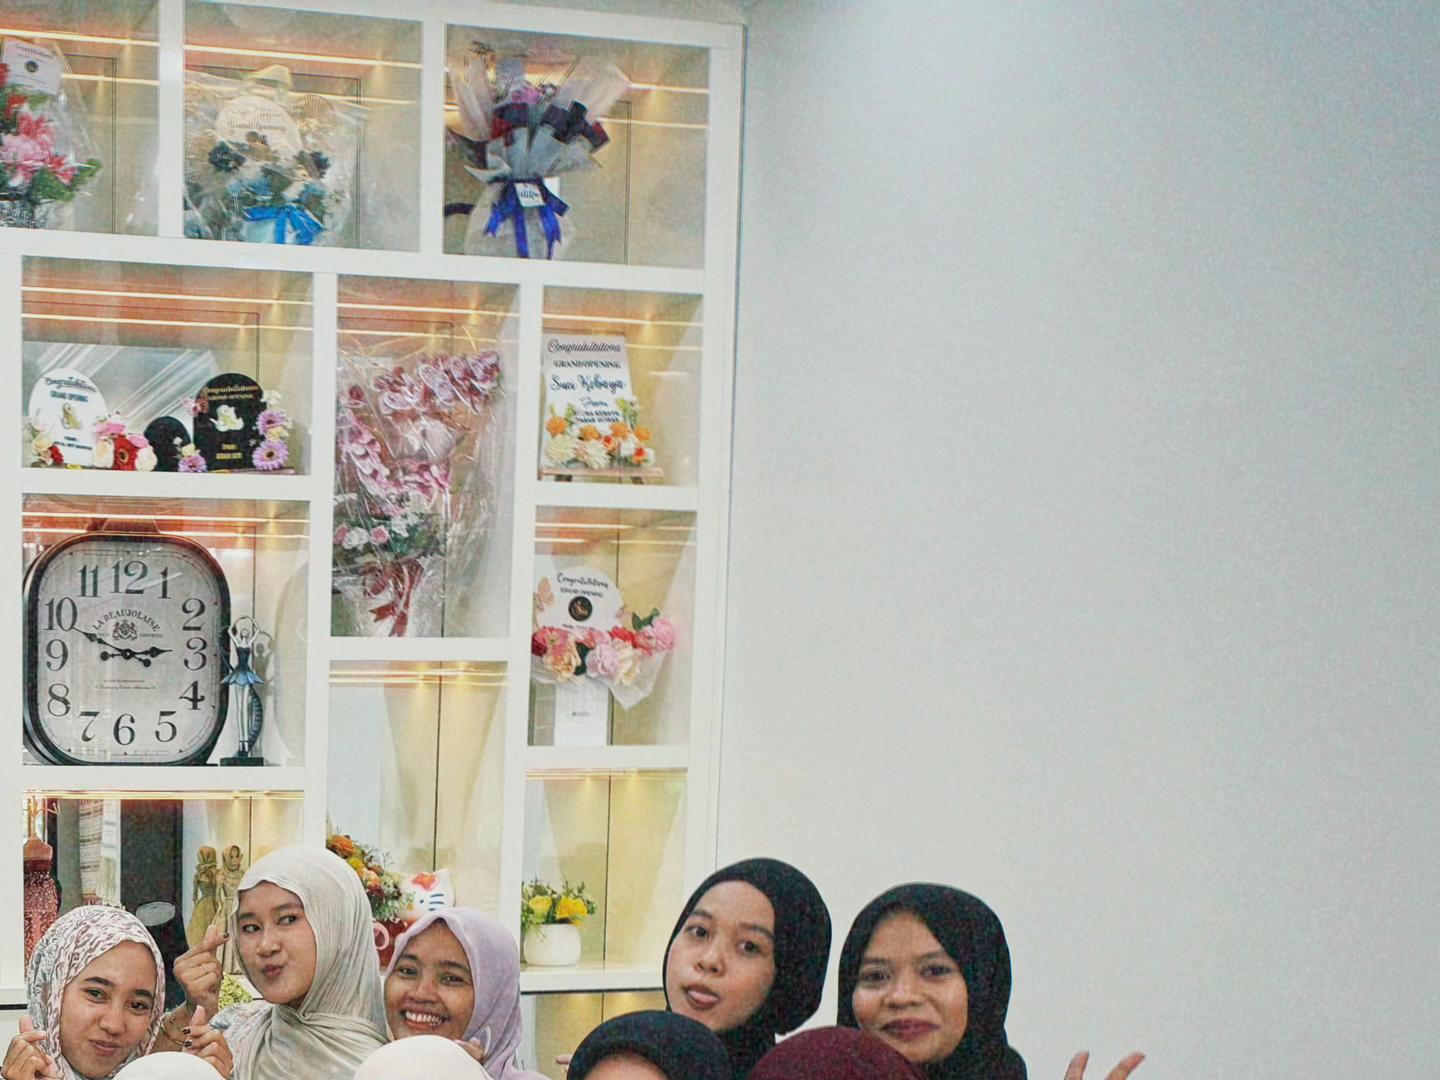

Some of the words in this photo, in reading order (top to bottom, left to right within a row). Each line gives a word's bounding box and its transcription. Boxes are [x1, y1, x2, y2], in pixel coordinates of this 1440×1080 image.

[78, 564, 101, 598] 11
[110, 561, 148, 595] 12
[157, 566, 171, 599] 1
[44, 597, 78, 631] 10
[181, 598, 205, 631] 2
[46, 638, 68, 671] 9
[184, 636, 207, 671] 3
[47, 683, 71, 717] 8
[178, 680, 205, 711] 4
[77, 711, 101, 742] 7
[113, 713, 136, 746] 6
[155, 711, 177, 743] 5
